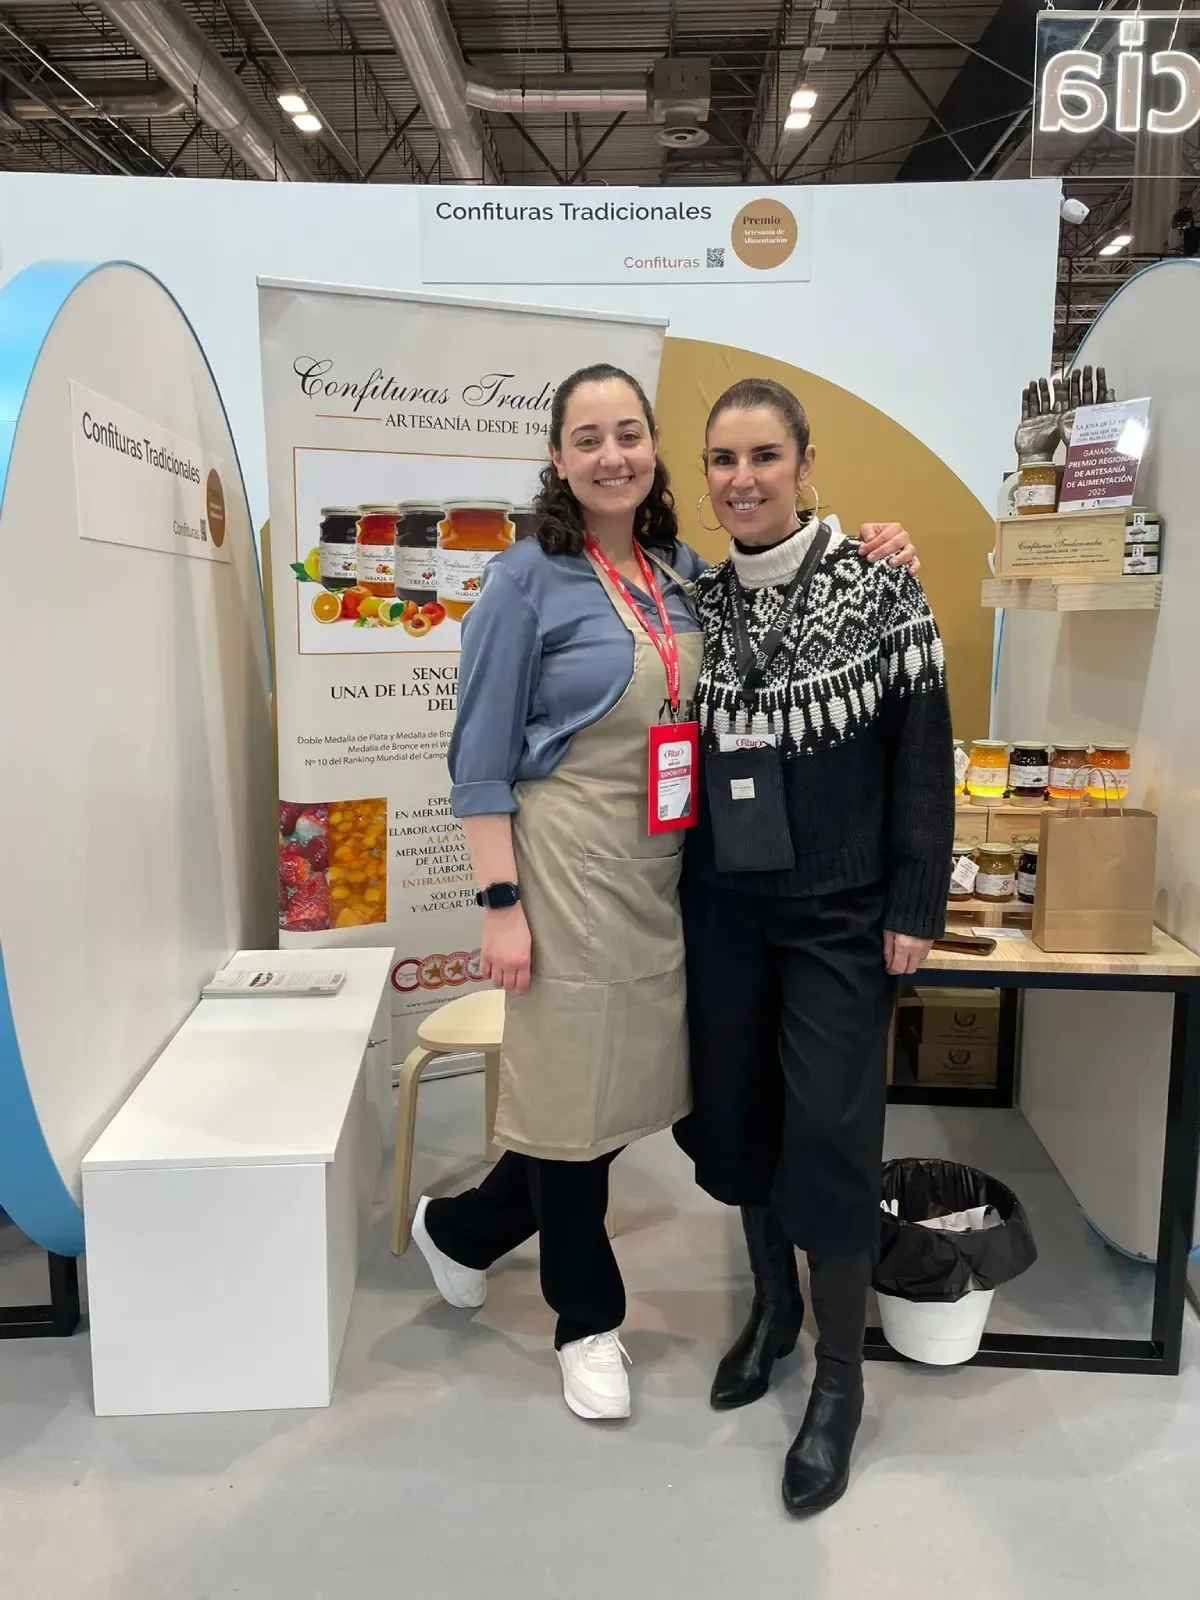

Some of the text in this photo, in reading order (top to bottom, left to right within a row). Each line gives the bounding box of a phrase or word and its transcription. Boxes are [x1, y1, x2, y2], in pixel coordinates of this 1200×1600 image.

[435, 202, 712, 221] Confituras Tradicionales
[743, 215, 781, 225] Premio
[623, 256, 700, 269] Confituras
[293, 355, 555, 412] Confituras Tradi
[385, 413, 471, 432] ARTESANÍA
[476, 419, 519, 434] DESDE
[82, 411, 201, 484] Confituras Tradicionales
[1083, 446, 1117, 457] GANADO
[1068, 458, 1097, 468] PREMIO
[1074, 464, 1126, 478] DE ARTESANÍA
[1066, 474, 1133, 488] DE ALIMENTACIÓN
[1088, 488, 1106, 497] 2025
[173, 520, 200, 540] Confituras
[773, 584, 804, 632] 1001 sabores
[412, 667, 459, 680] SENCI
[330, 685, 369, 699] UNA
[375, 684, 396, 697] DE
[401, 683, 430, 697] LAS
[428, 698, 457, 711] DEL
[297, 736, 323, 745] Doble
[324, 735, 356, 744] Medalla
[357, 734, 368, 742] de
[369, 733, 389, 742] Plata
[396, 731, 427, 740] Medalla
[740, 739, 758, 747] Fitur
[347, 745, 379, 753] Medalla
[392, 742, 419, 750] Bronce
[668, 750, 681, 758] Fitur
[329, 757, 342, 766] del
[343, 756, 375, 765] Ranking
[376, 753, 408, 762] Mundial
[409, 752, 422, 760] del
[660, 767, 687, 778] EXPOSITOR
[395, 811, 409, 819] EN
[389, 823, 463, 836] ELABORACIÓN
[437, 835, 449, 843] LA
[396, 843, 465, 857] MERMELADAS
[415, 857, 428, 866] DE
[431, 855, 457, 864] ALTA
[428, 863, 473, 875] ELABORA
[402, 872, 475, 888] ENTERAMENTE
[430, 890, 457, 901] SÓLO
[411, 905, 418, 913] Y
[421, 900, 462, 912] AZÚCAR
